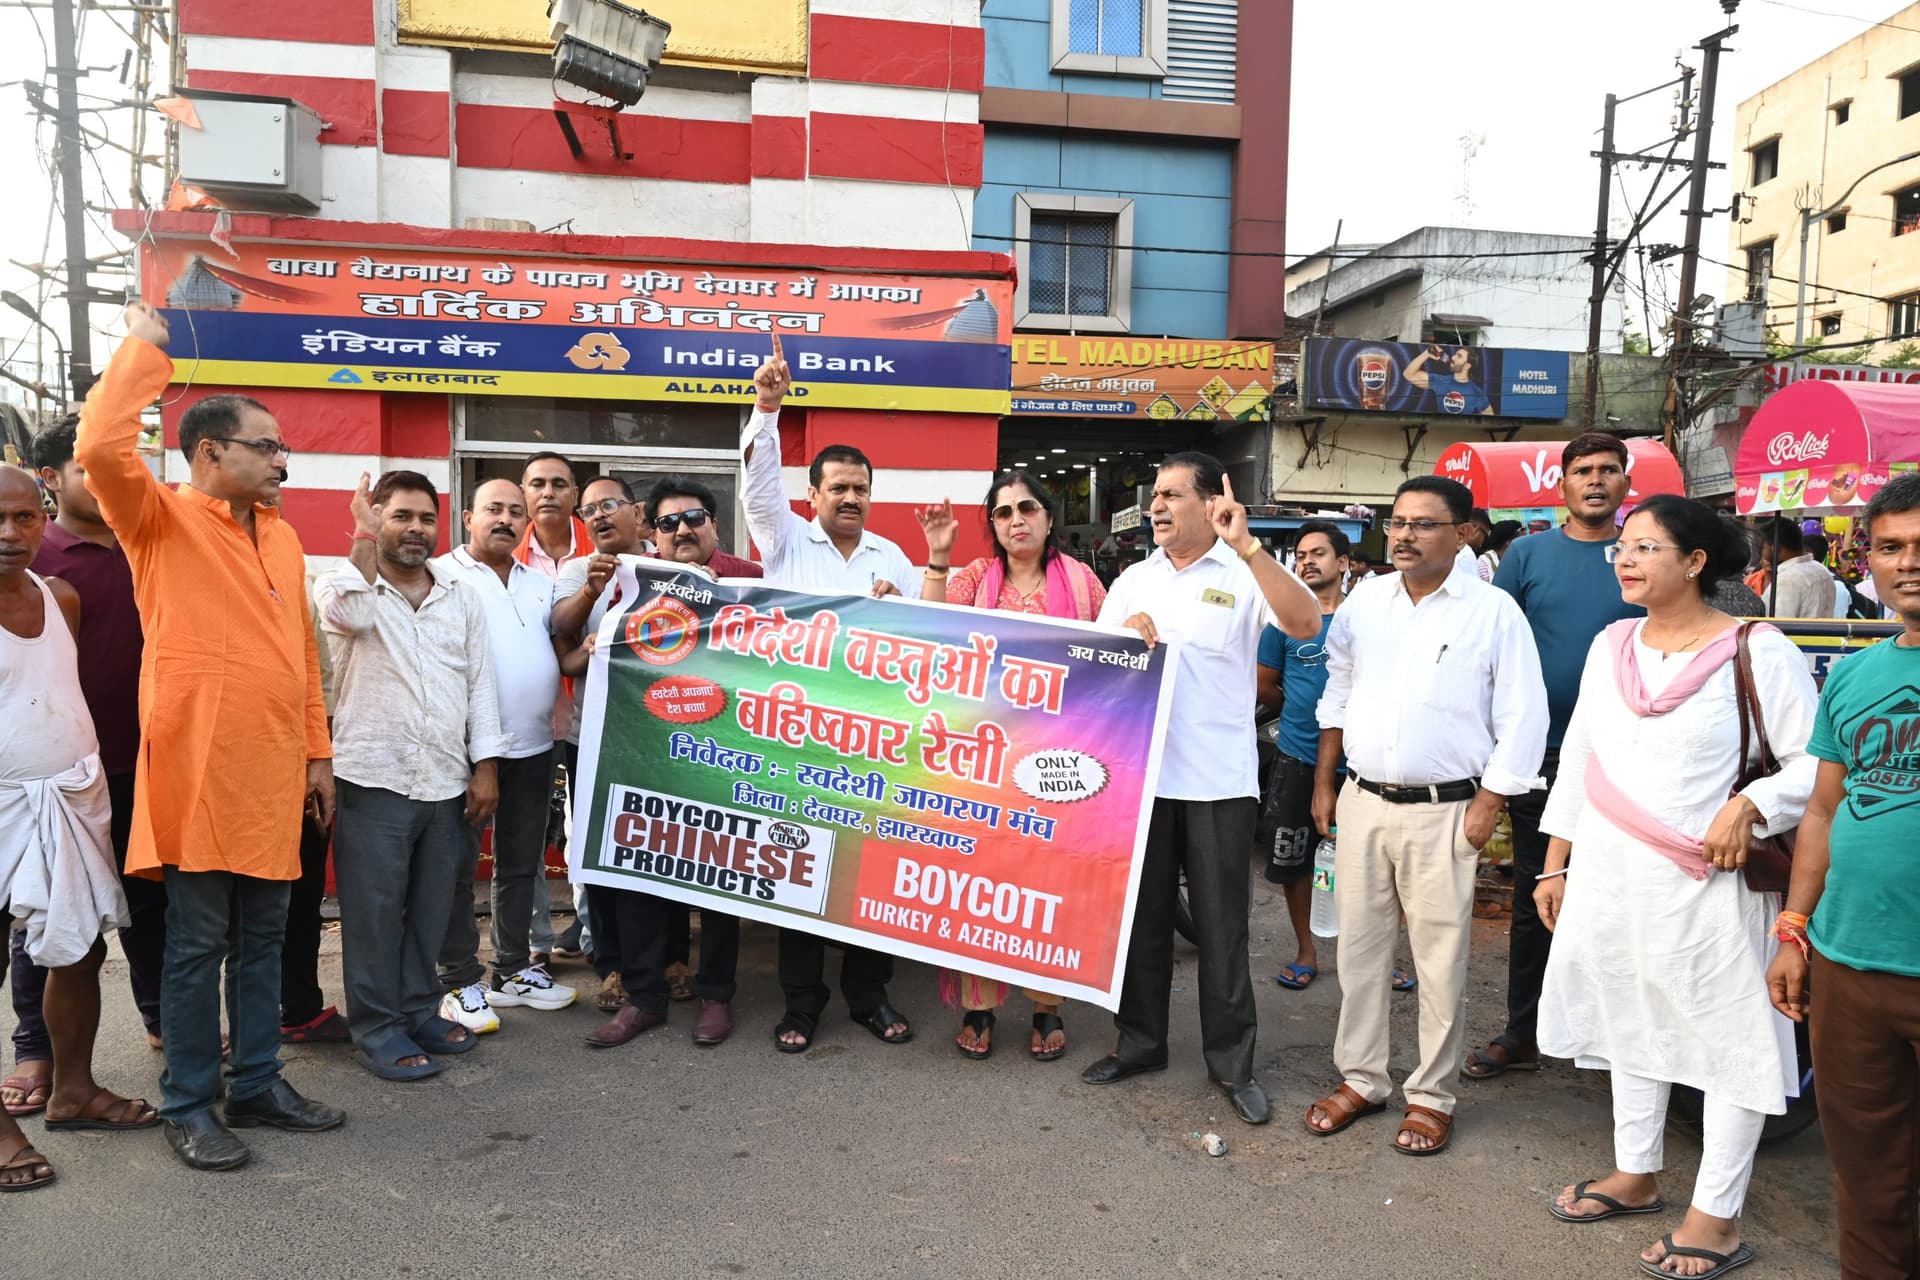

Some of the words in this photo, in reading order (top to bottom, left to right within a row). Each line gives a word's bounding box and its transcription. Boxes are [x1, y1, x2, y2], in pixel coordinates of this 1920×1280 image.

[266, 258, 337, 277] बाबा
[350, 255, 469, 284] बैद्यनाथ
[480, 262, 514, 286] के
[525, 269, 608, 289] पावन
[620, 270, 682, 296] भूमि
[694, 272, 778, 297] देवघर
[788, 273, 817, 299] में
[827, 283, 921, 304] आपका
[358, 289, 546, 320] हार्दिक
[569, 296, 825, 333] अभिनंदन
[301, 328, 432, 356] इंडियन
[437, 335, 501, 358] बैंक
[1011, 338, 1068, 365] TEL
[1079, 340, 1270, 370] MADHUBAN
[799, 352, 896, 373] Bank
[1362, 371, 1385, 380] PEPSI
[1519, 369, 1549, 380] HOTEL
[372, 370, 500, 386] इलाहाबाद
[1040, 373, 1092, 392] होटल
[1512, 383, 1557, 395] MADHURI
[1057, 400, 1069, 410] के
[1071, 400, 1093, 411] लिए
[1444, 399, 1464, 407] PEPSI
[1768, 431, 1829, 466] Rollick
[649, 579, 667, 592] जय
[668, 583, 713, 605] स्वदेशी
[707, 604, 842, 671] विदेशी
[844, 626, 998, 705] वस्तुओं
[1001, 654, 1069, 715] का
[1068, 644, 1096, 661] जय
[1098, 649, 1150, 671] स्वदेशी
[650, 686, 679, 699] स्वदेशी
[736, 681, 912, 766] बहिष्कार
[921, 712, 1011, 788] रैली
[1035, 756, 1080, 769] ONLY
[1041, 771, 1067, 779] MADE
[1885, 753, 1920, 770] STE
[669, 732, 765, 773] निवेदक
[796, 762, 886, 802] स्वदेशी
[893, 783, 1000, 827] जागरण
[1007, 806, 1058, 840] मंच
[1039, 779, 1086, 793] INDIA
[622, 791, 761, 841] BOYCOTT
[733, 781, 786, 811] जिला
[877, 816, 977, 855] झारखण्ड
[613, 813, 816, 888] CHINESE
[613, 846, 776, 901] PRODUCTS
[894, 857, 1063, 934] BOYCOTT
[859, 897, 934, 934] TURKEY
[938, 917, 951, 939] &
[957, 922, 1081, 970] AZERBAIJAN
